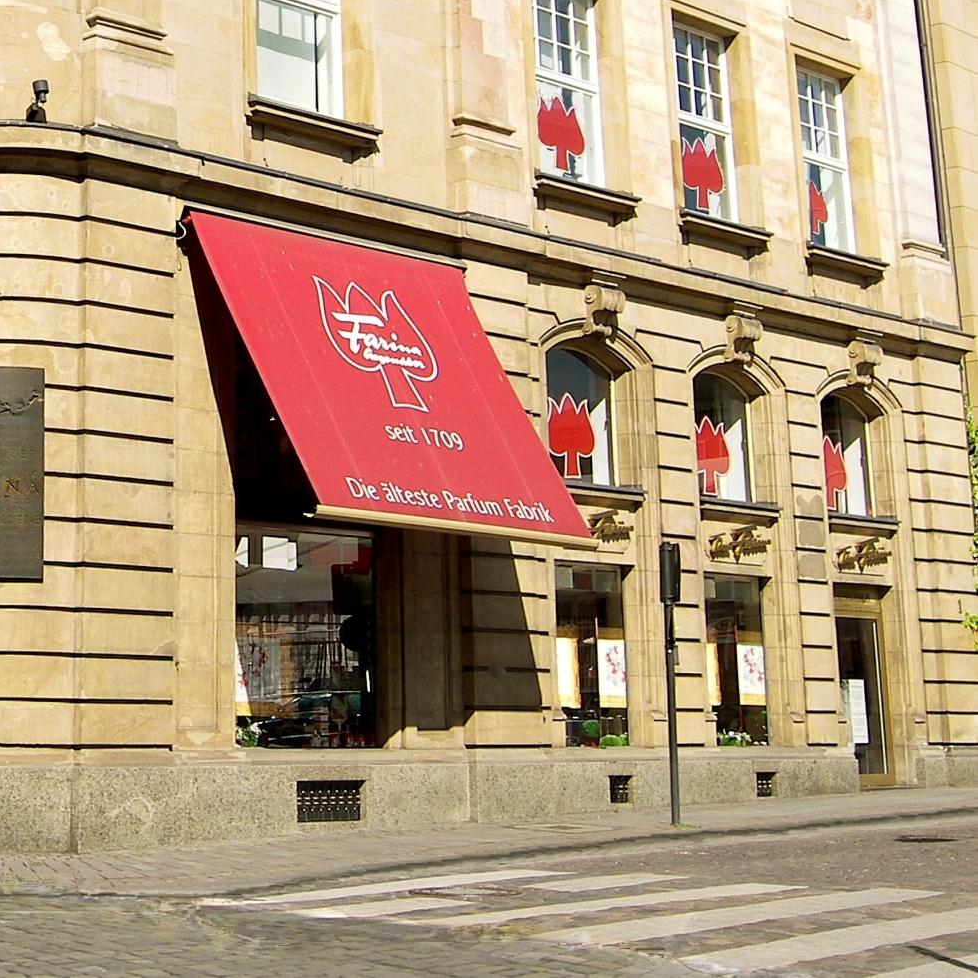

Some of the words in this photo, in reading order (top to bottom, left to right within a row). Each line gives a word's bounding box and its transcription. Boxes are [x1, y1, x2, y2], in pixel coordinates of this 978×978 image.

[331, 311, 423, 357] Farina
[384, 424, 418, 444] seit
[421, 428, 464, 451] 1709
[344, 476, 380, 501] Die
[382, 482, 443, 509] älteste
[441, 490, 504, 517] Parfum
[506, 499, 556, 524] Fabrik
